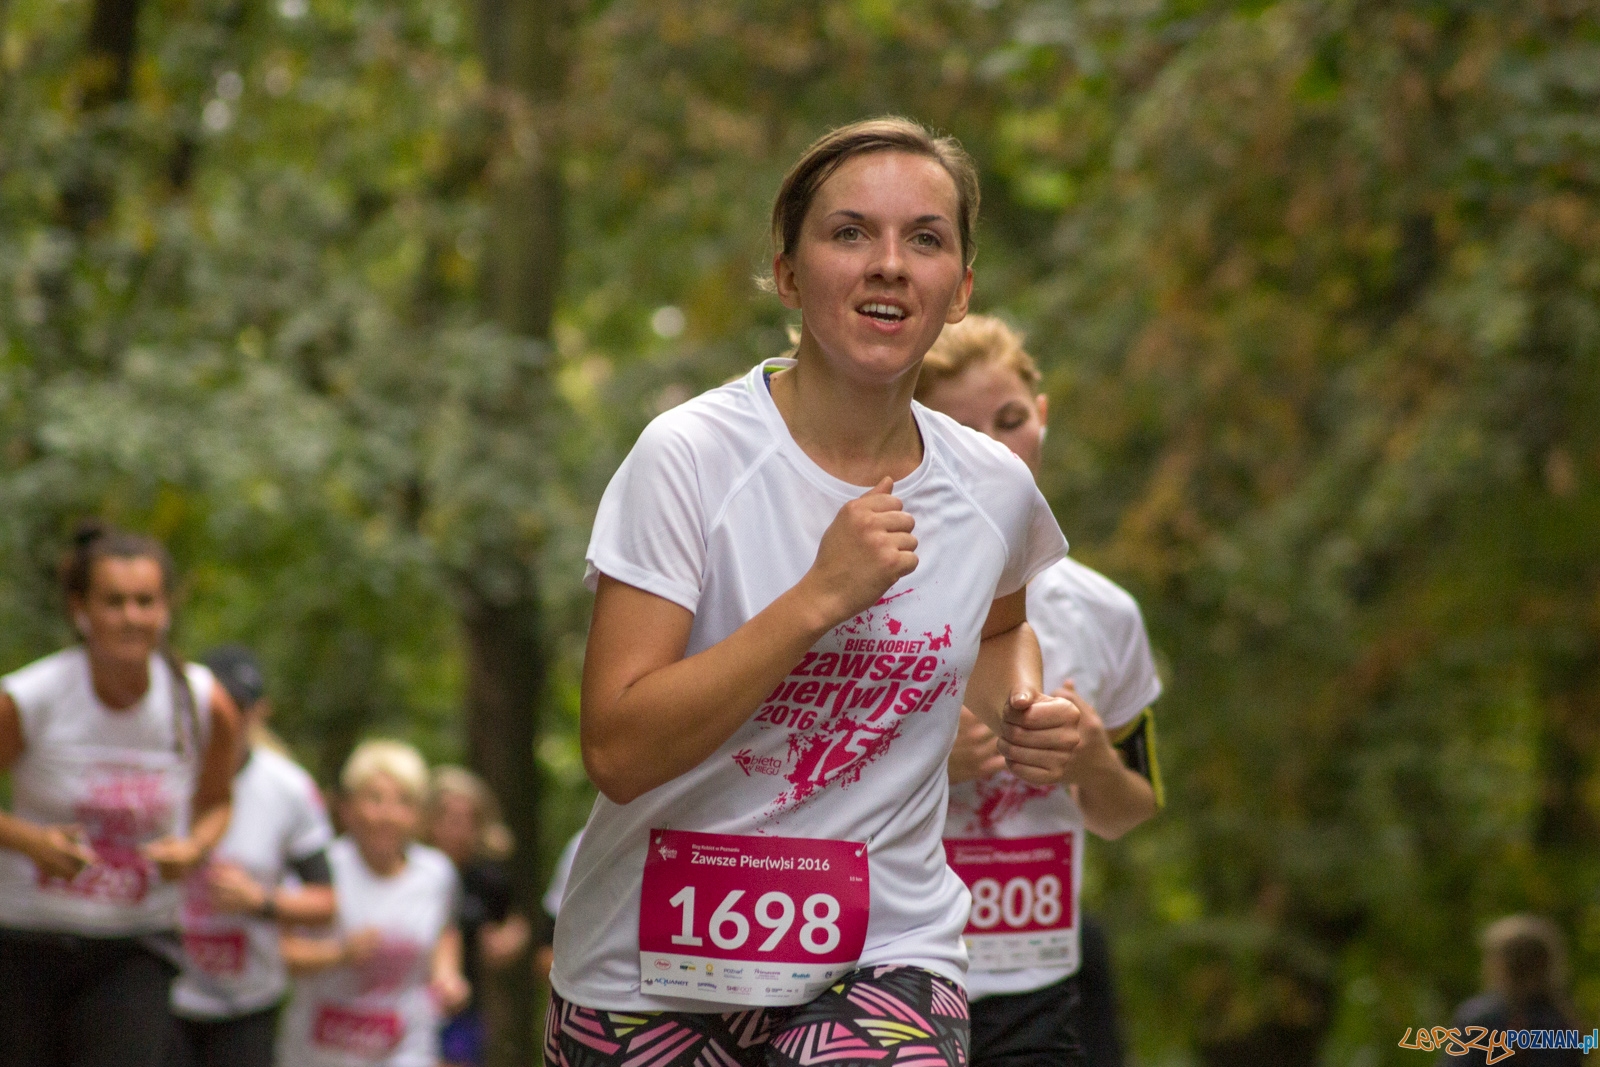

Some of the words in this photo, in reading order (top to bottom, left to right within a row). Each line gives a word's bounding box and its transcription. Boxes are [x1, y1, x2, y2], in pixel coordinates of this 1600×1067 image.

[844, 638, 876, 652] BIEG
[876, 639, 925, 654] KOBIET
[790, 651, 938, 682] zawsze
[753, 705, 818, 730] 2016
[691, 851, 737, 867] Zawsze
[740, 855, 794, 872] Pier(w)si
[797, 858, 830, 871] 2016
[668, 885, 841, 955] 1698
